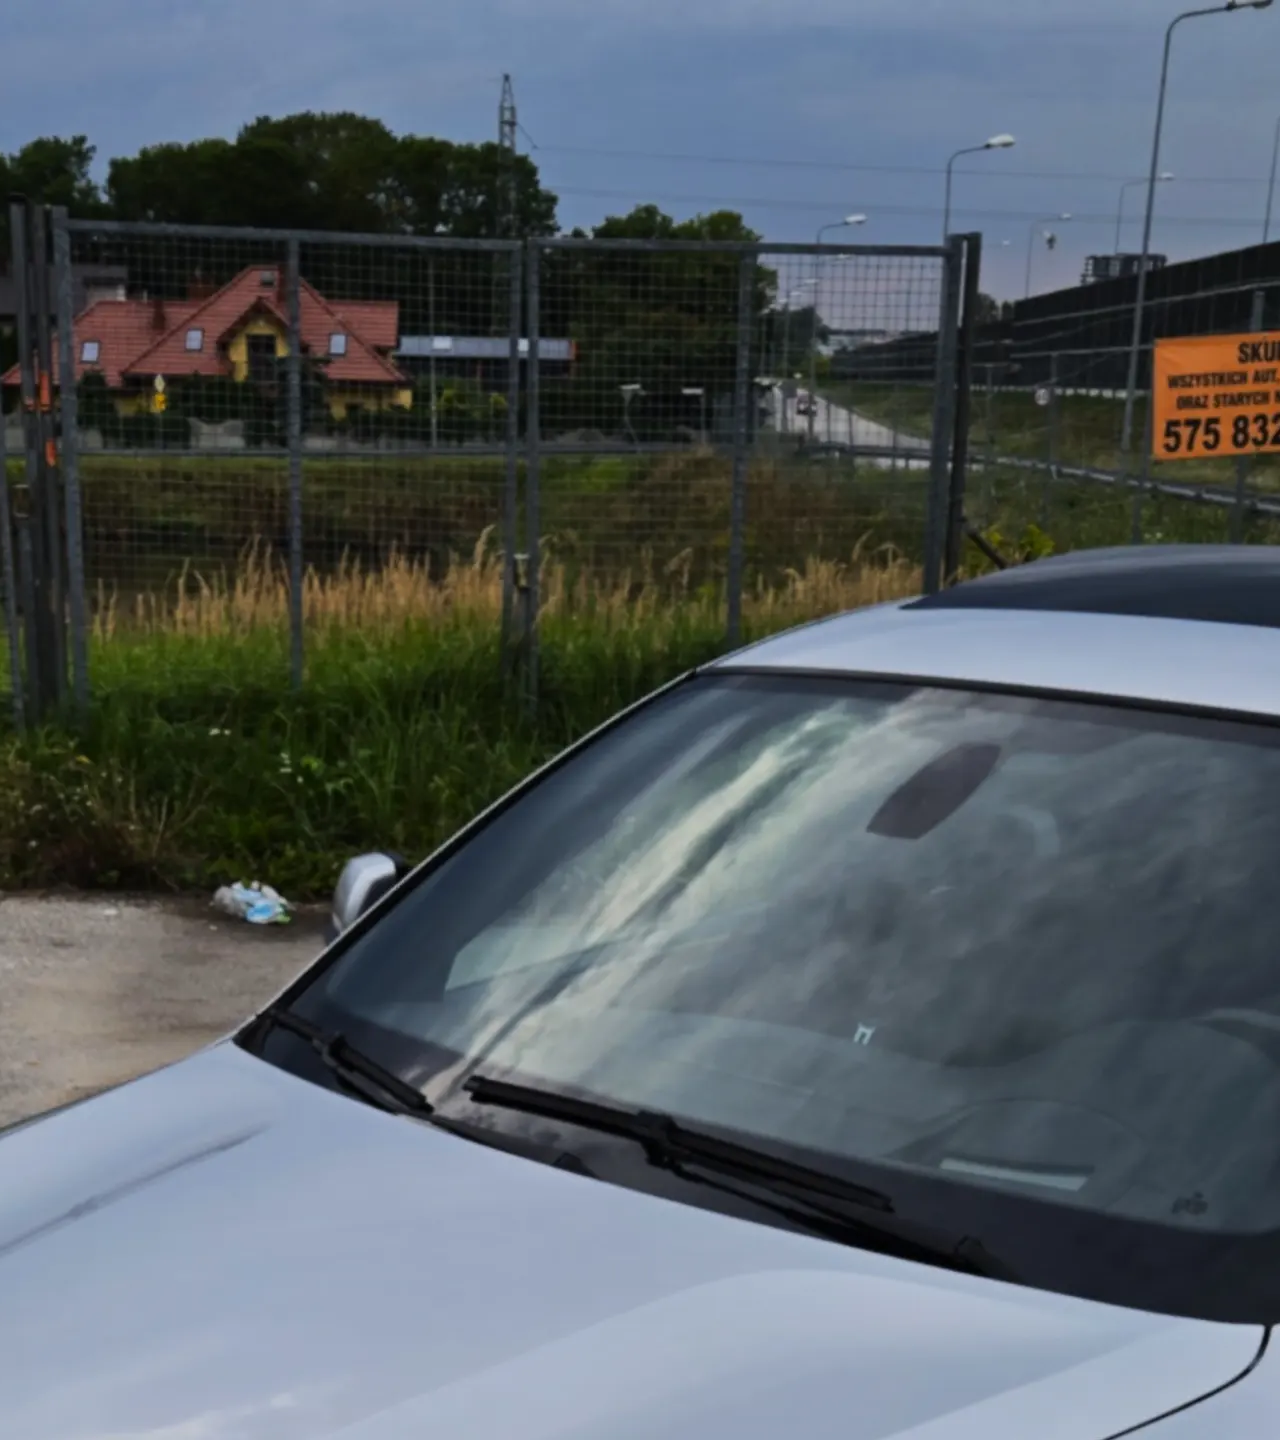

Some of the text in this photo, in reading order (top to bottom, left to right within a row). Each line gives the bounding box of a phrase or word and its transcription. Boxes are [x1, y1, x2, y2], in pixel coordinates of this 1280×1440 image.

[1167, 370, 1248, 389] WSZYSTKICH
[1176, 395, 1208, 410] ORAZ
[1213, 391, 1270, 408] STARYCH
[1163, 417, 1220, 453] 575
